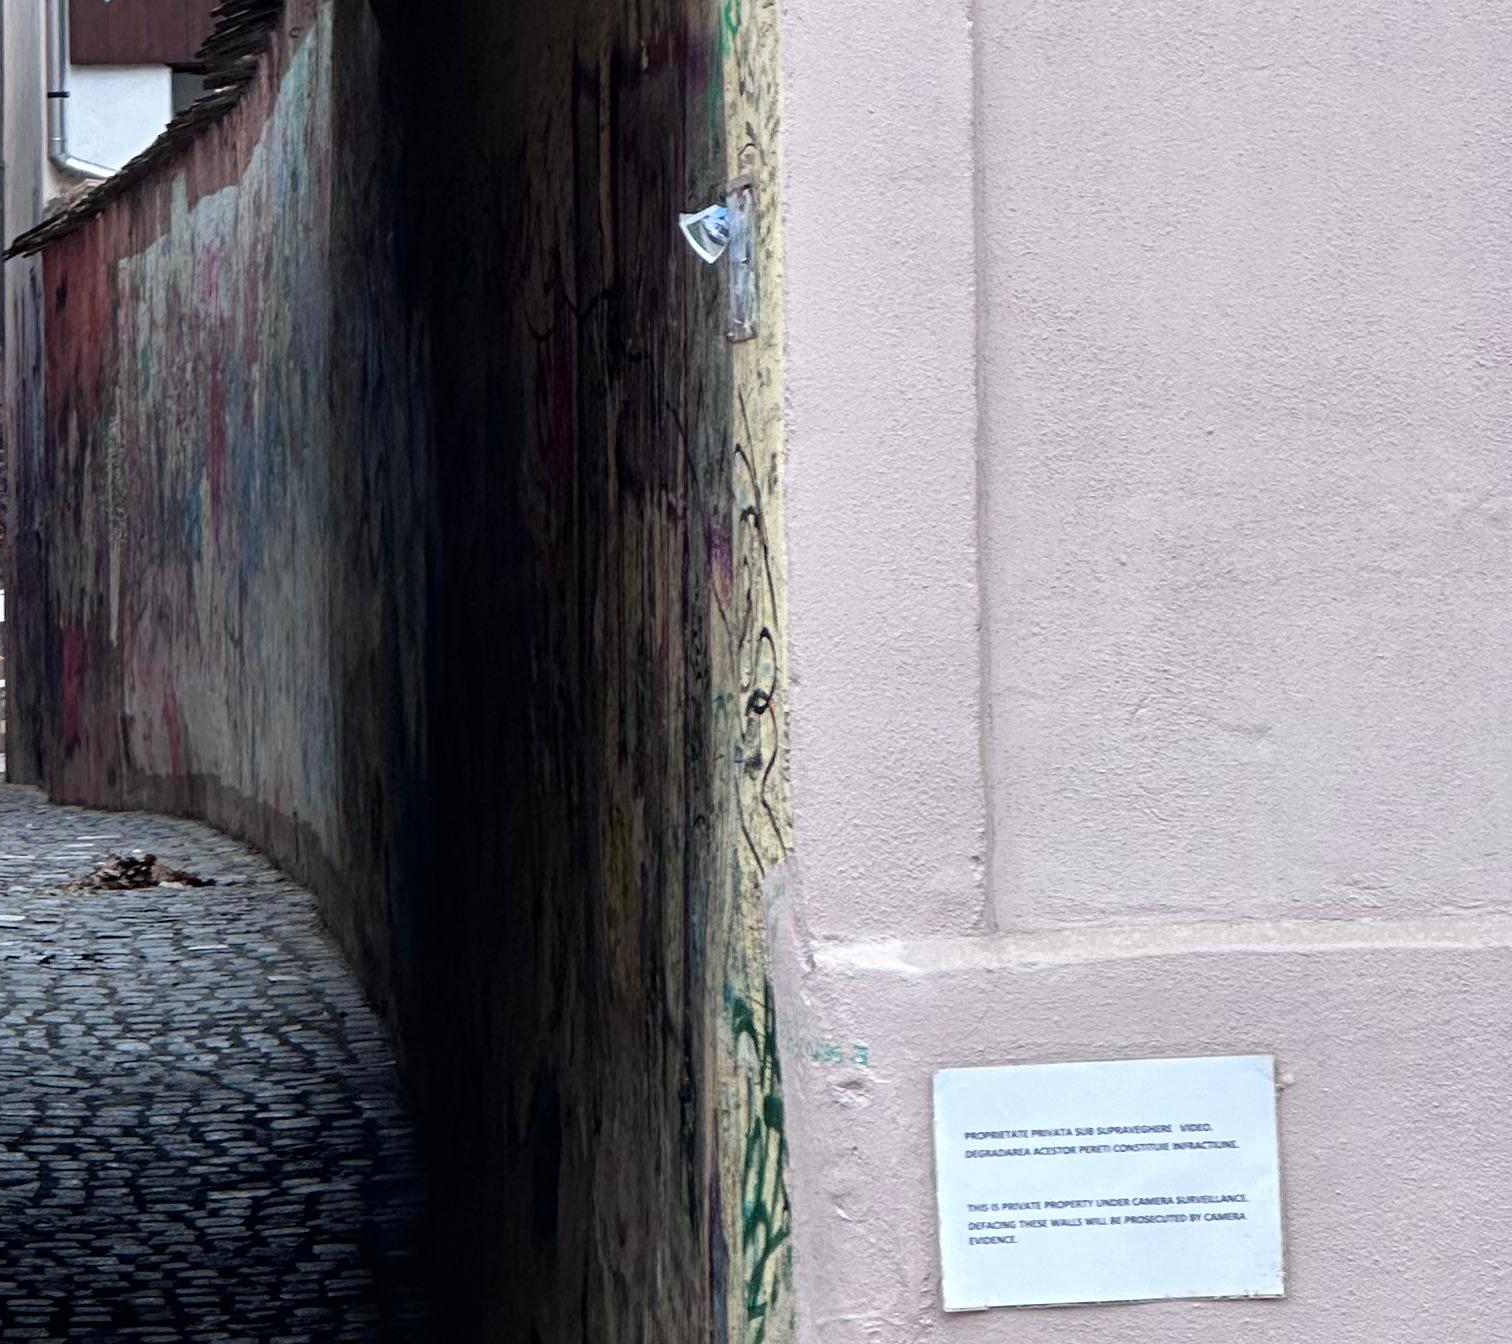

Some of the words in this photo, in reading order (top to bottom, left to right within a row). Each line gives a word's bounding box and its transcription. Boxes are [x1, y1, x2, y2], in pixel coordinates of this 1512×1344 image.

[964, 1130, 1029, 1140] PROPRIETATE
[1075, 1127, 1094, 1136] SUB
[1002, 1201, 1041, 1210] PRIVATE
[1044, 1199, 1093, 1209] PROPERTY
[1096, 1198, 1130, 1207] UNDER
[1132, 1196, 1174, 1206] CAMERA
[968, 1221, 1017, 1231] DEFACING
[1050, 1218, 1082, 1227] WALLS
[1085, 1217, 1107, 1226] WILL
[1124, 1214, 1187, 1224] PROSECUTED
